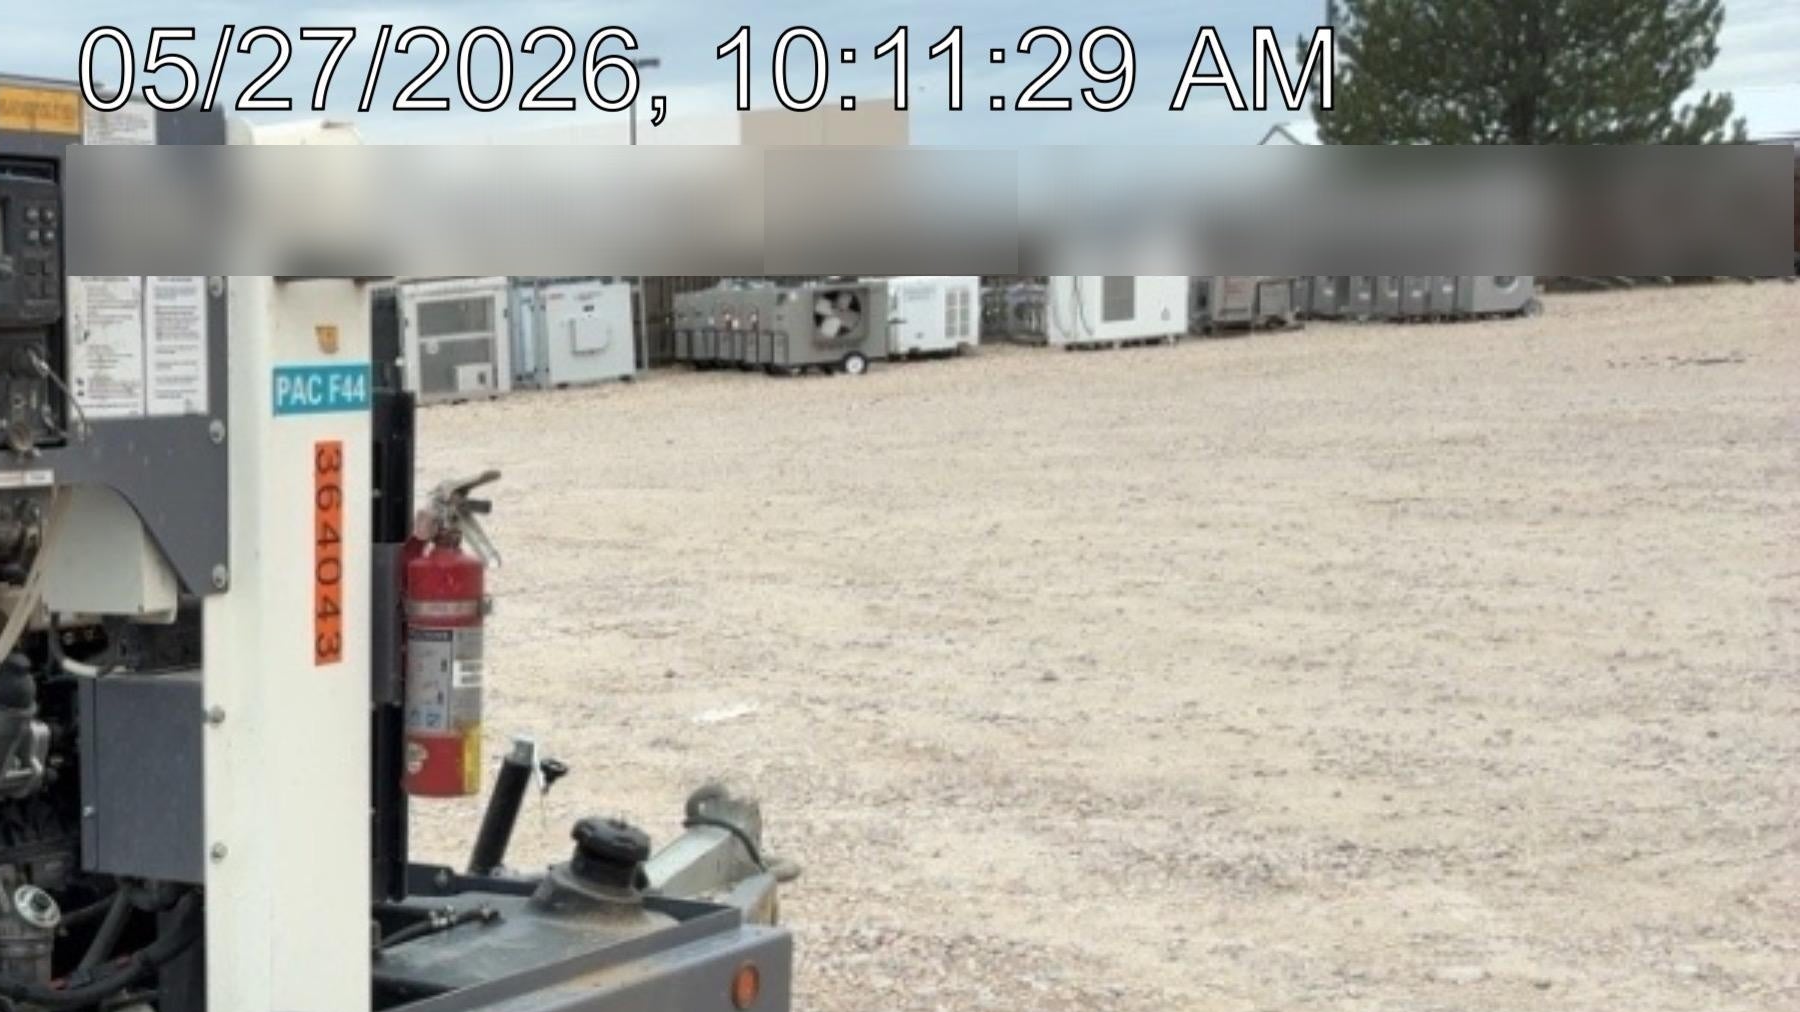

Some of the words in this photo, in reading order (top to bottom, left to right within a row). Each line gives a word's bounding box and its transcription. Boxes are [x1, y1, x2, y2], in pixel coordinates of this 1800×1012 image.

[276, 374, 322, 406] PAC
[328, 373, 365, 403] F44
[315, 447, 343, 658] 364043
